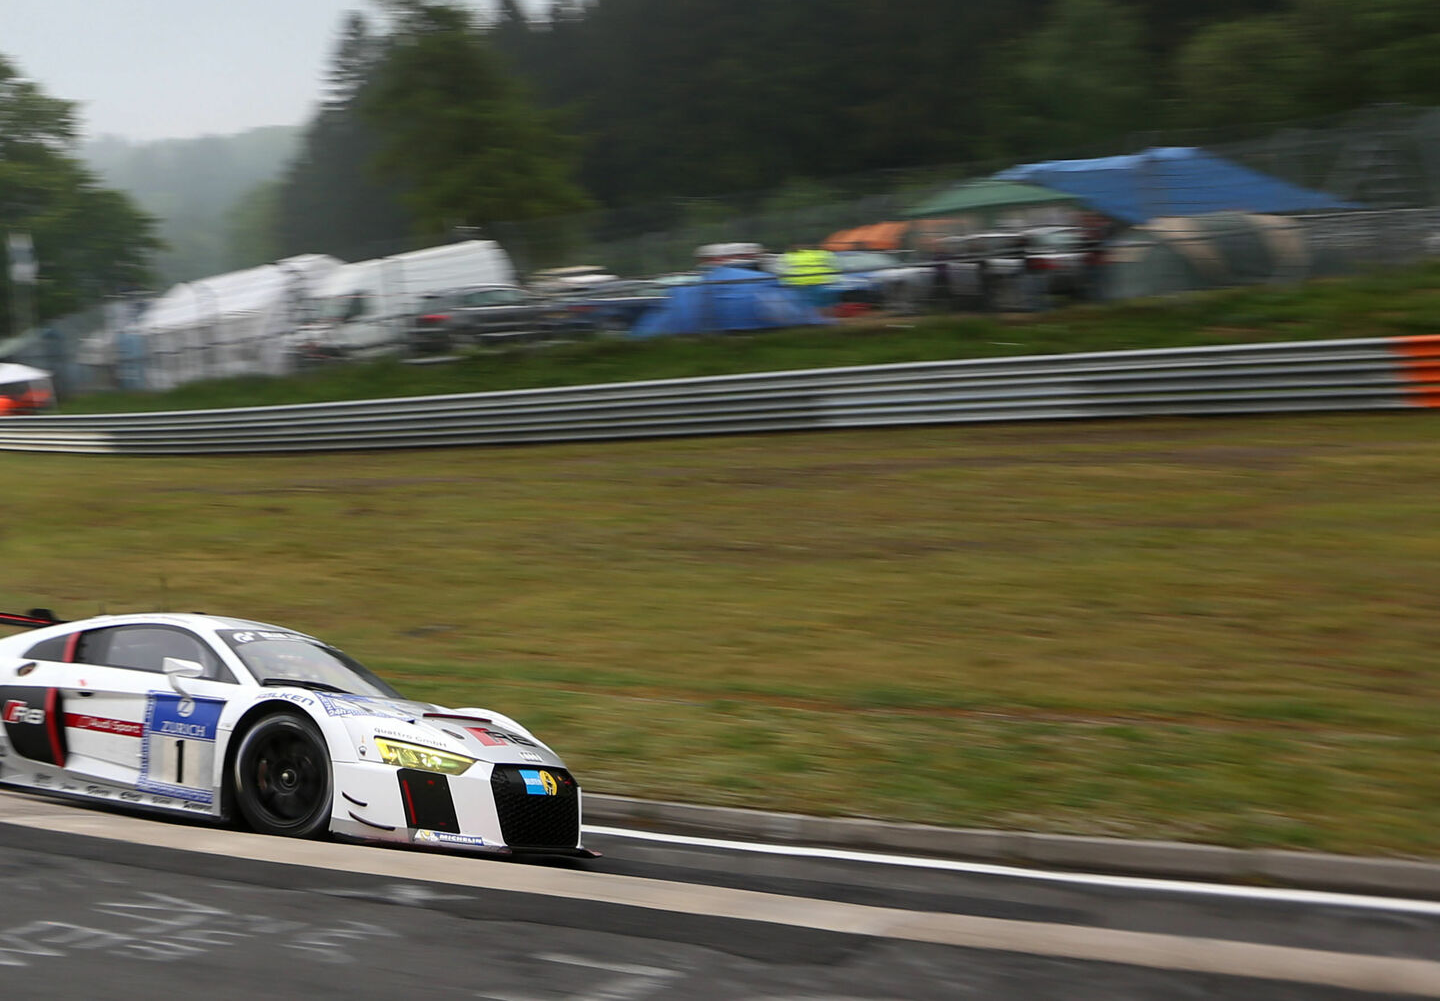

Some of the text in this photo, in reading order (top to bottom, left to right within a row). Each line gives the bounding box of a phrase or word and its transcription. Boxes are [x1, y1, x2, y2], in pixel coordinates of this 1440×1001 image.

[2, 700, 45, 725] R8
[89, 718, 141, 734] Audi Sport
[160, 720, 207, 737] ZURICH
[374, 727, 413, 740] quattro
[175, 739, 185, 784] 1
[438, 834, 483, 845] MICHELIN
